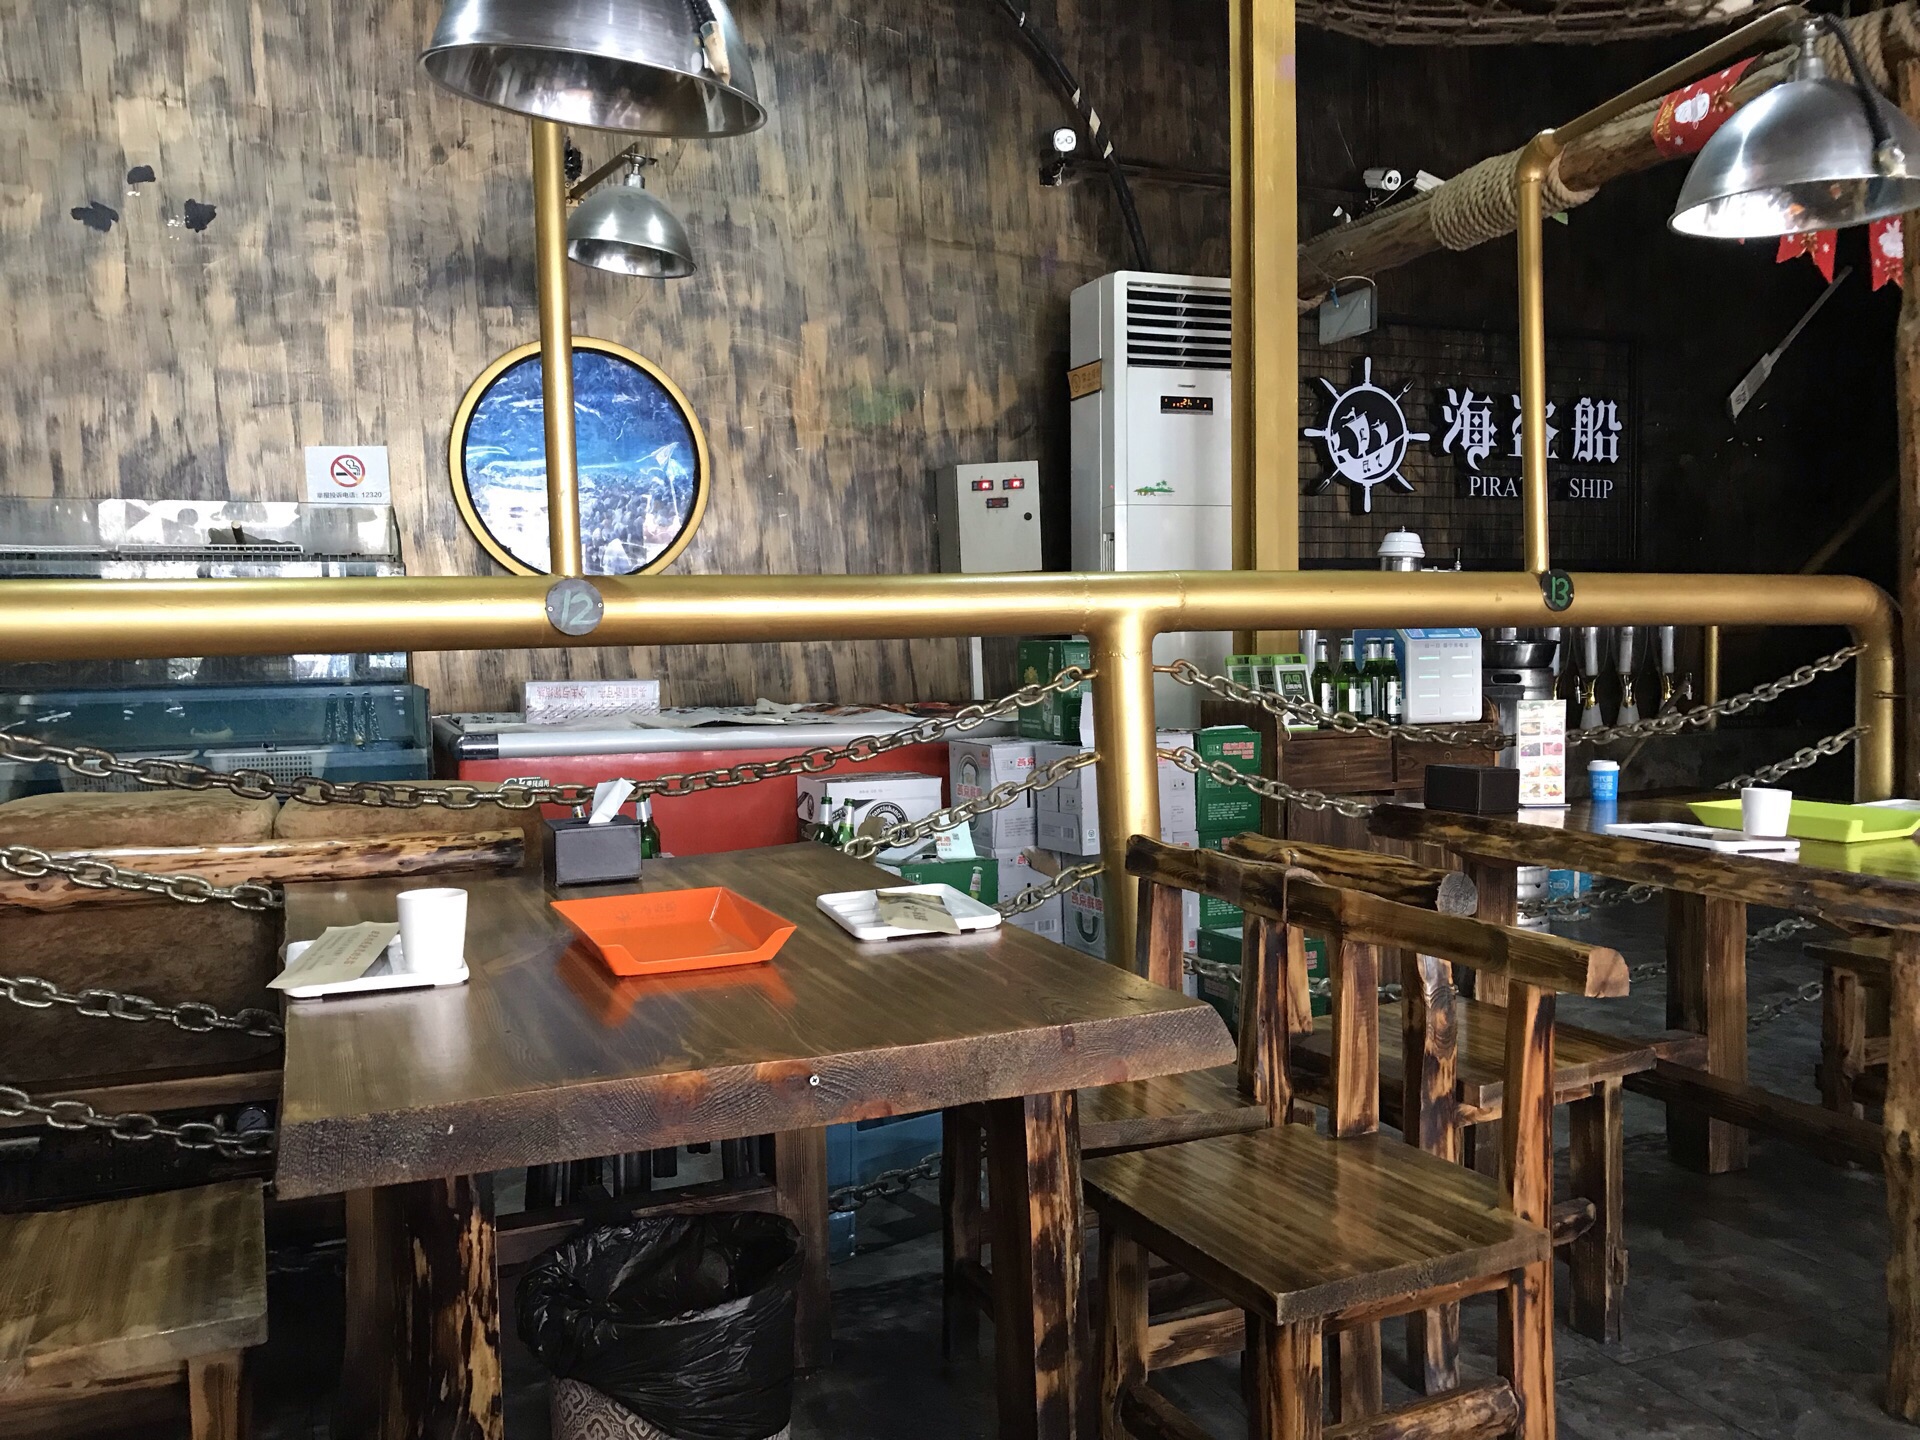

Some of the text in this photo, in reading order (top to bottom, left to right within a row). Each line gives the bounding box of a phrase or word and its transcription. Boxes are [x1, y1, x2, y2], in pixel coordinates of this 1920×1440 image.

[1469, 476, 1614, 499] PIRA SHIP
[1551, 576, 1569, 607] 13
[561, 589, 598, 628] 12
